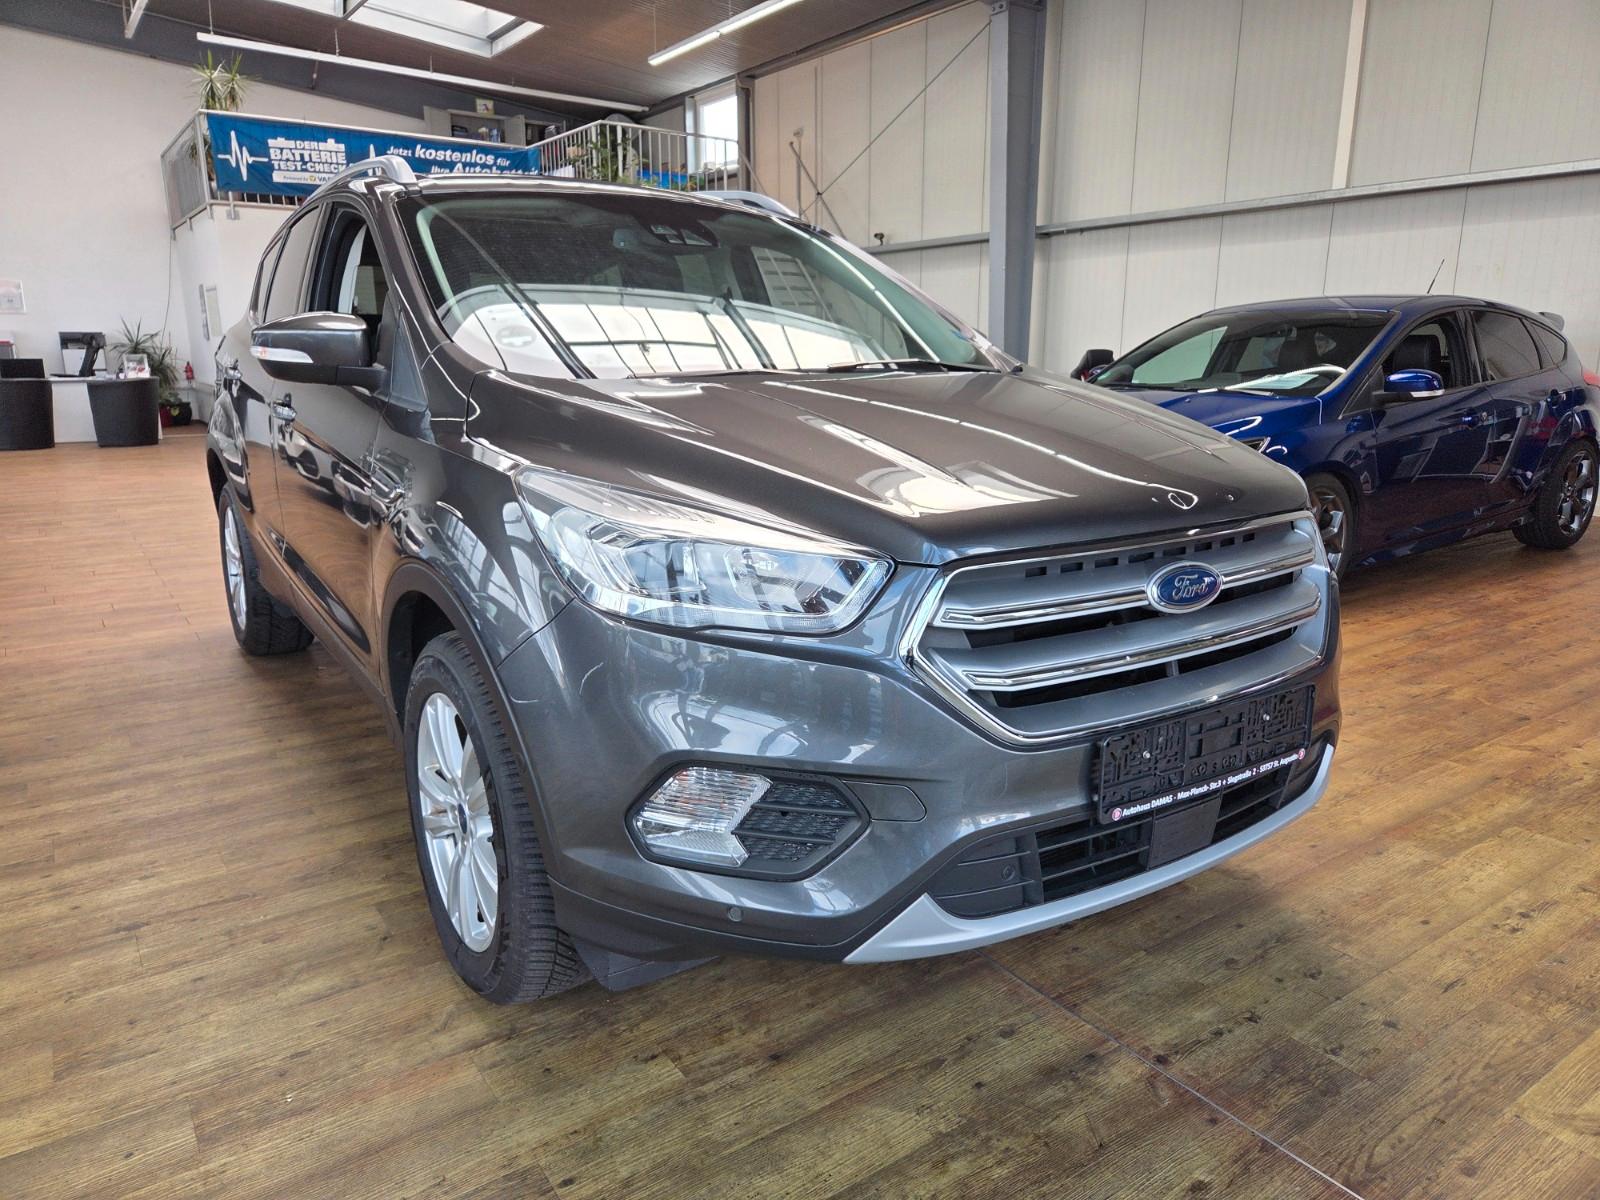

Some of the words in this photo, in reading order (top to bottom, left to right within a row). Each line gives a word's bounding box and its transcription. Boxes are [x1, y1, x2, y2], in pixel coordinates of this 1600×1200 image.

[269, 148, 347, 164] BATTERIE
[296, 140, 318, 150] DER
[386, 146, 412, 157] Jetzt
[415, 144, 496, 165] kostenlos
[496, 157, 511, 167] für
[1172, 574, 1209, 600] Ford
[1122, 802, 1151, 817] Autohaus
[1151, 794, 1174, 809] DAMAS
